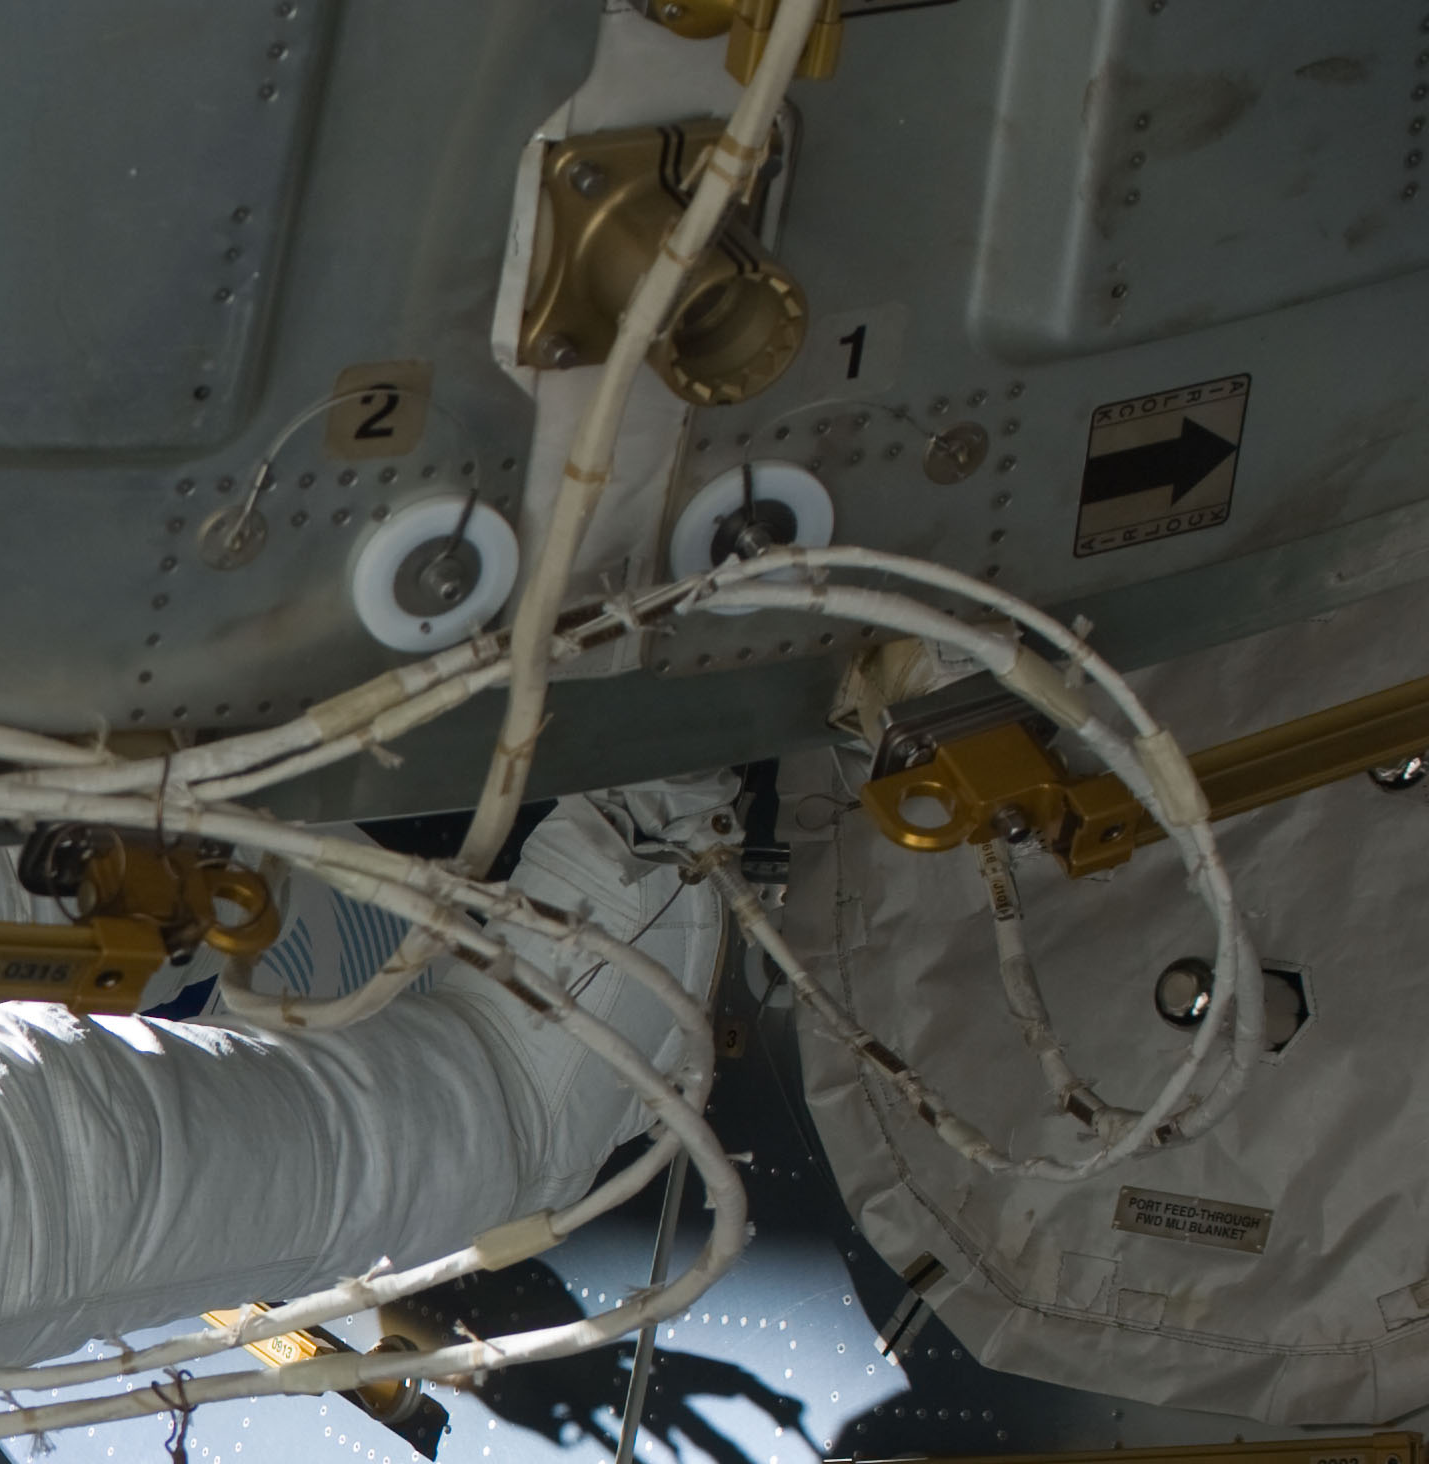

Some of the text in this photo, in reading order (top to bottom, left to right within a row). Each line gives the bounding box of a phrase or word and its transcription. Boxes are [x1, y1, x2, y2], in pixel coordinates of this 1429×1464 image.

[839, 324, 867, 379] 1
[354, 383, 400, 440] 2
[1129, 1196, 1262, 1229] PORT FEED-THROUGH
[1135, 1213, 1247, 1241] FWD MLI BLANKET
